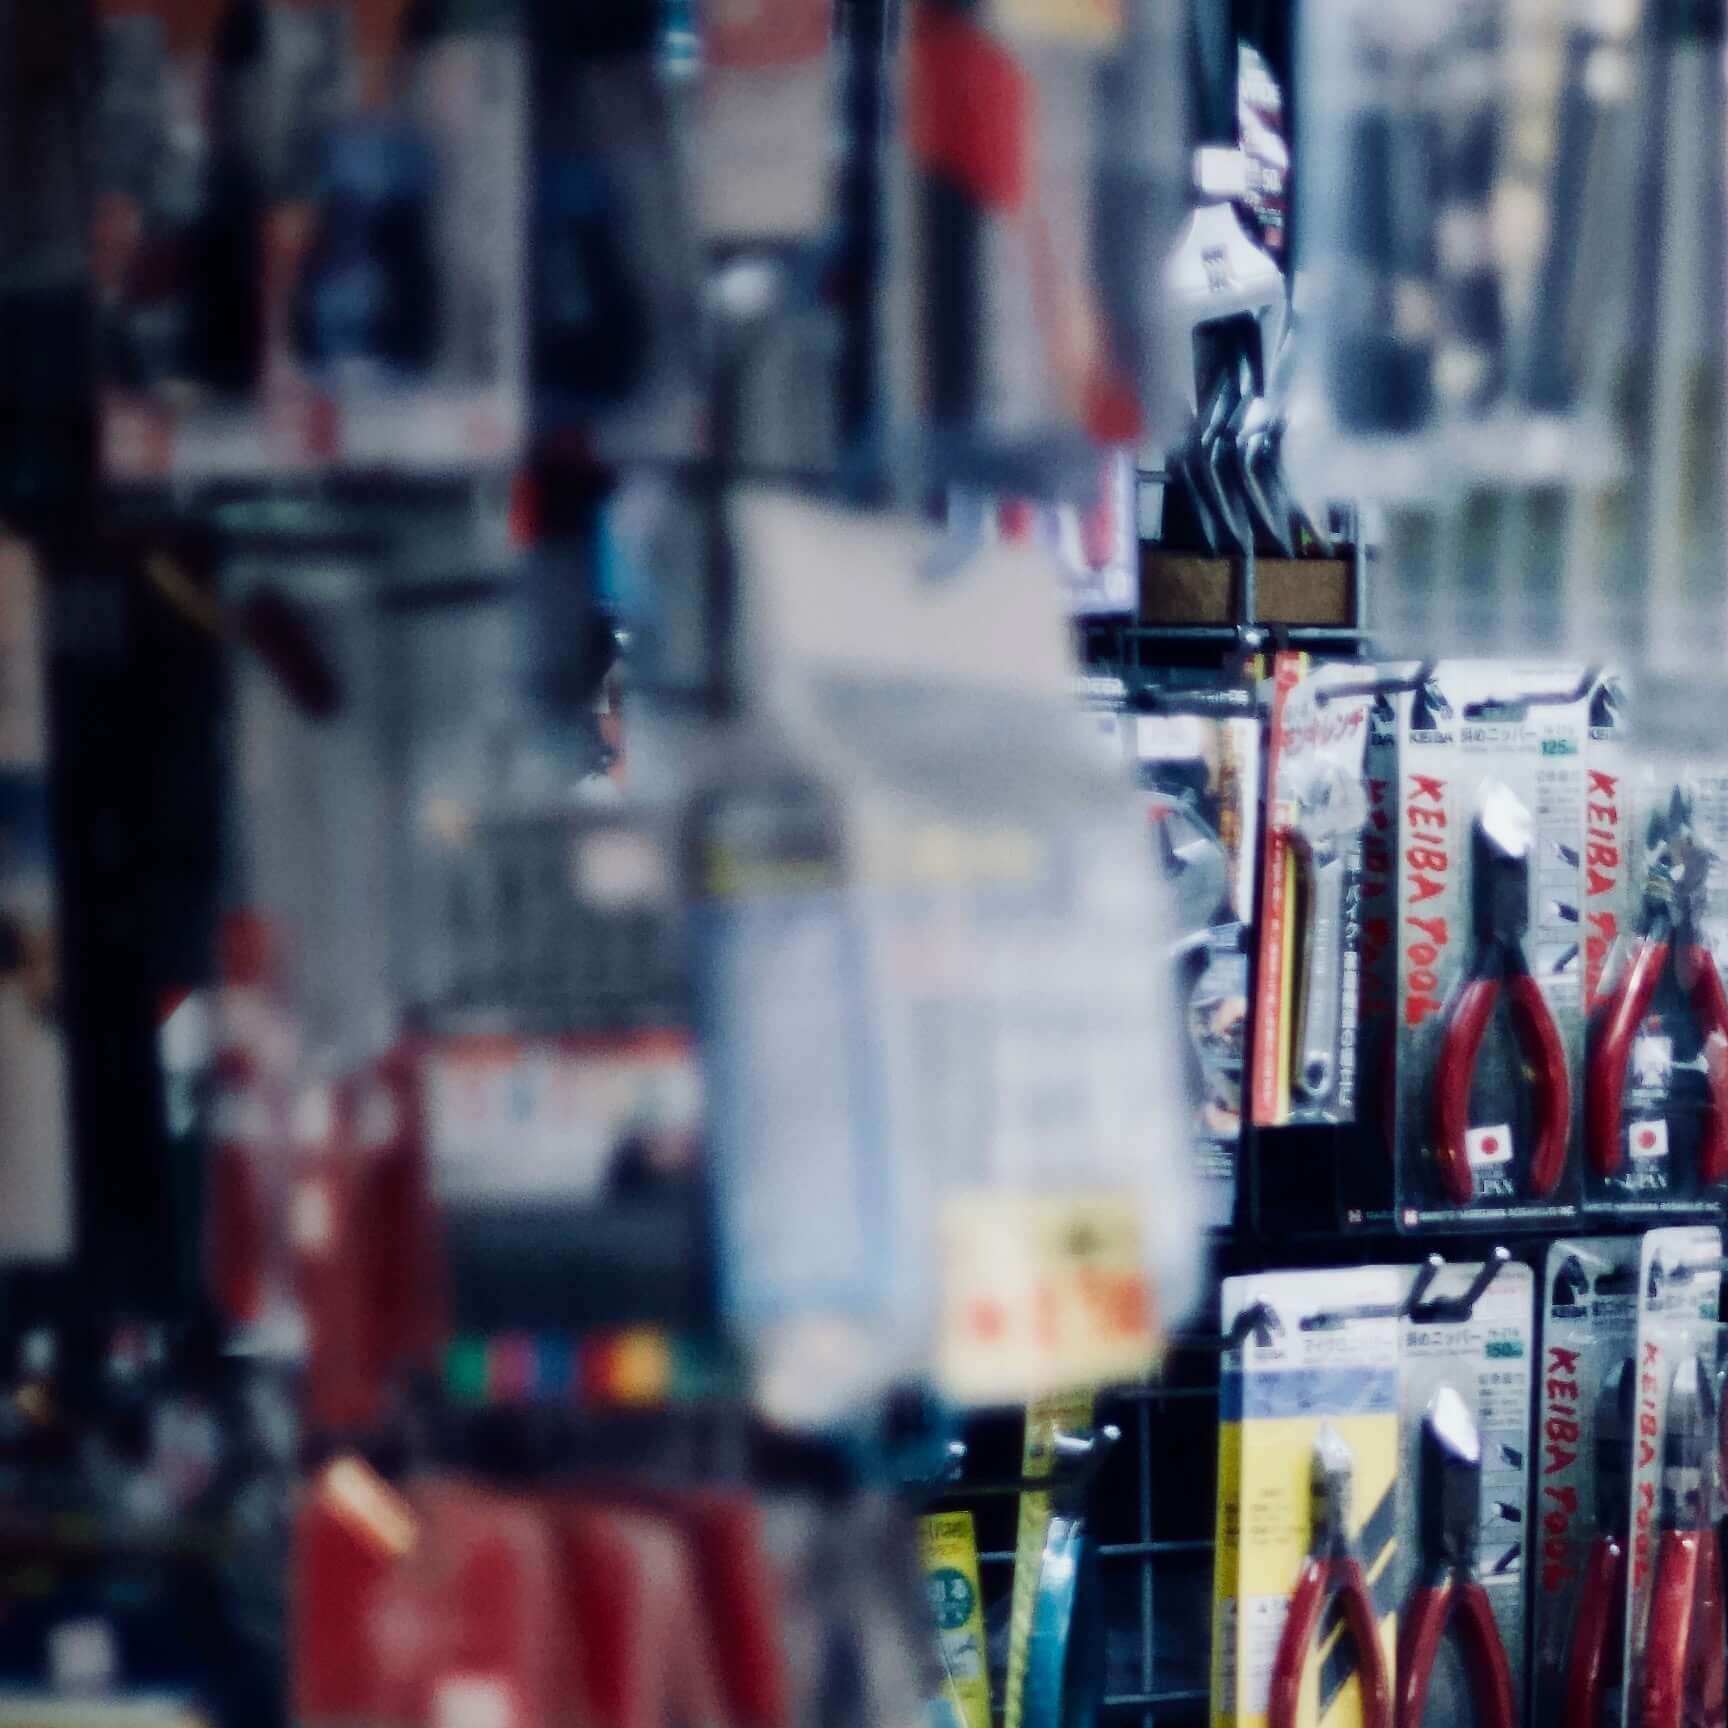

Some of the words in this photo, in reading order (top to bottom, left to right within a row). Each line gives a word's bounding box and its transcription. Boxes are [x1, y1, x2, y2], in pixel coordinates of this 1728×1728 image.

[1405, 773, 1448, 904] KEIBA
[1586, 769, 1619, 897] KEIBA
[1403, 916, 1448, 1029] TOOL
[1543, 1345, 1582, 1476] KEIBA
[1635, 1340, 1658, 1470] KEIBA
